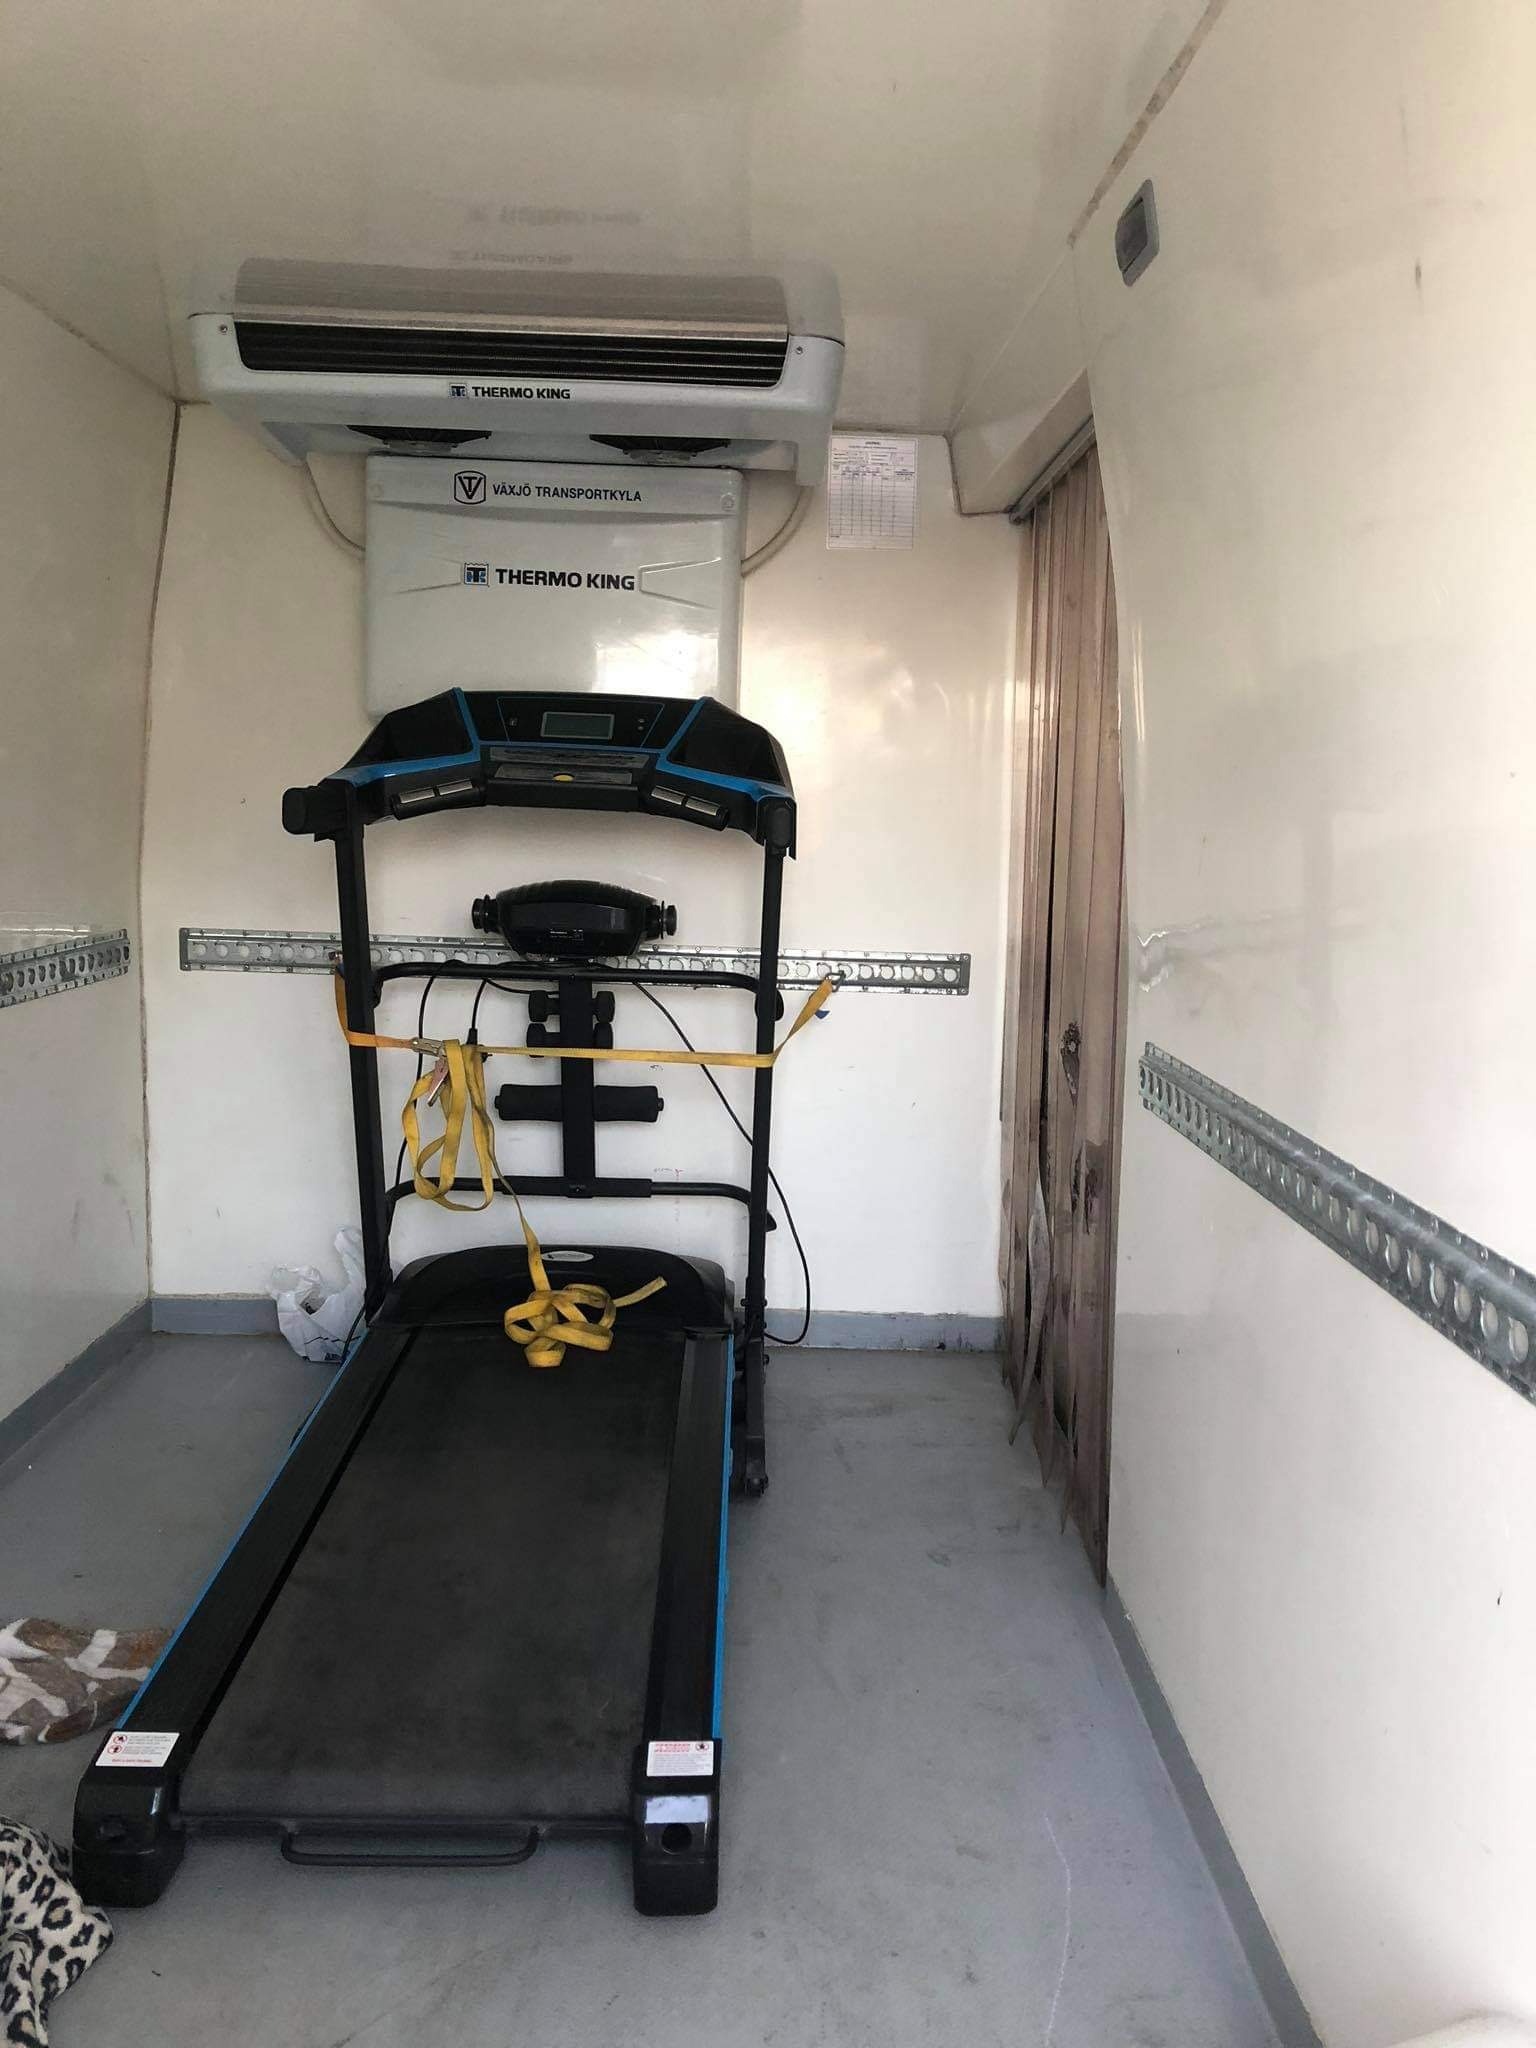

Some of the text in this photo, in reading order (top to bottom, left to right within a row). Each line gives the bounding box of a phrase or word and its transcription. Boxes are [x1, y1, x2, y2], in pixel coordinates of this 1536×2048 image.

[472, 386, 534, 399] THERMO
[537, 388, 571, 400] KING
[493, 481, 532, 497] VÄXJÖ
[536, 486, 642, 502] TRANSPORTKYLA
[496, 568, 582, 588] THERMO
[587, 573, 636, 591] KING
